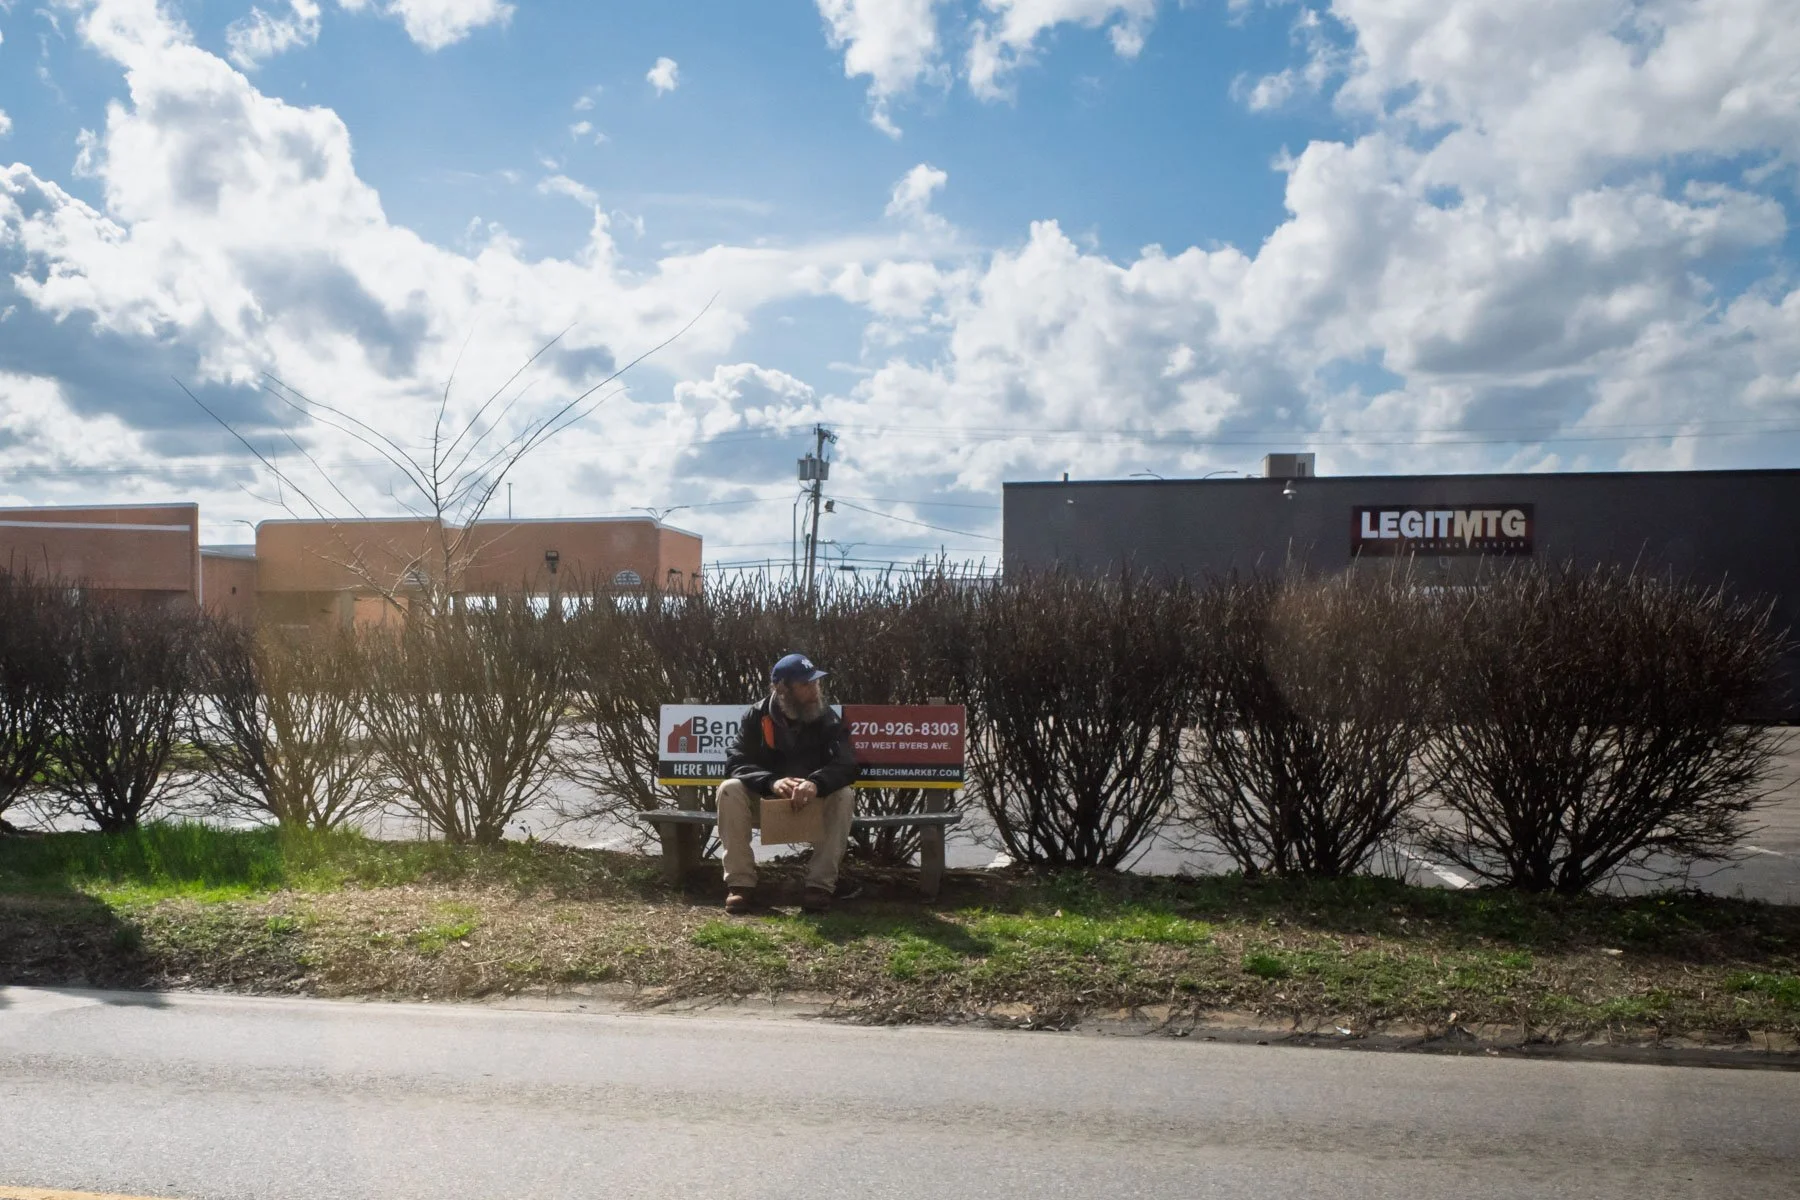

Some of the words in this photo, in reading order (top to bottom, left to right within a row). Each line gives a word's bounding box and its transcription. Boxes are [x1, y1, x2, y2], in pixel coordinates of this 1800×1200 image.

[1361, 509, 1526, 548] LEGITMTG
[692, 716, 739, 735] Ben
[850, 722, 959, 736] 270-926-8303
[931, 742, 951, 750] AVE.
[673, 763, 702, 776] HERE
